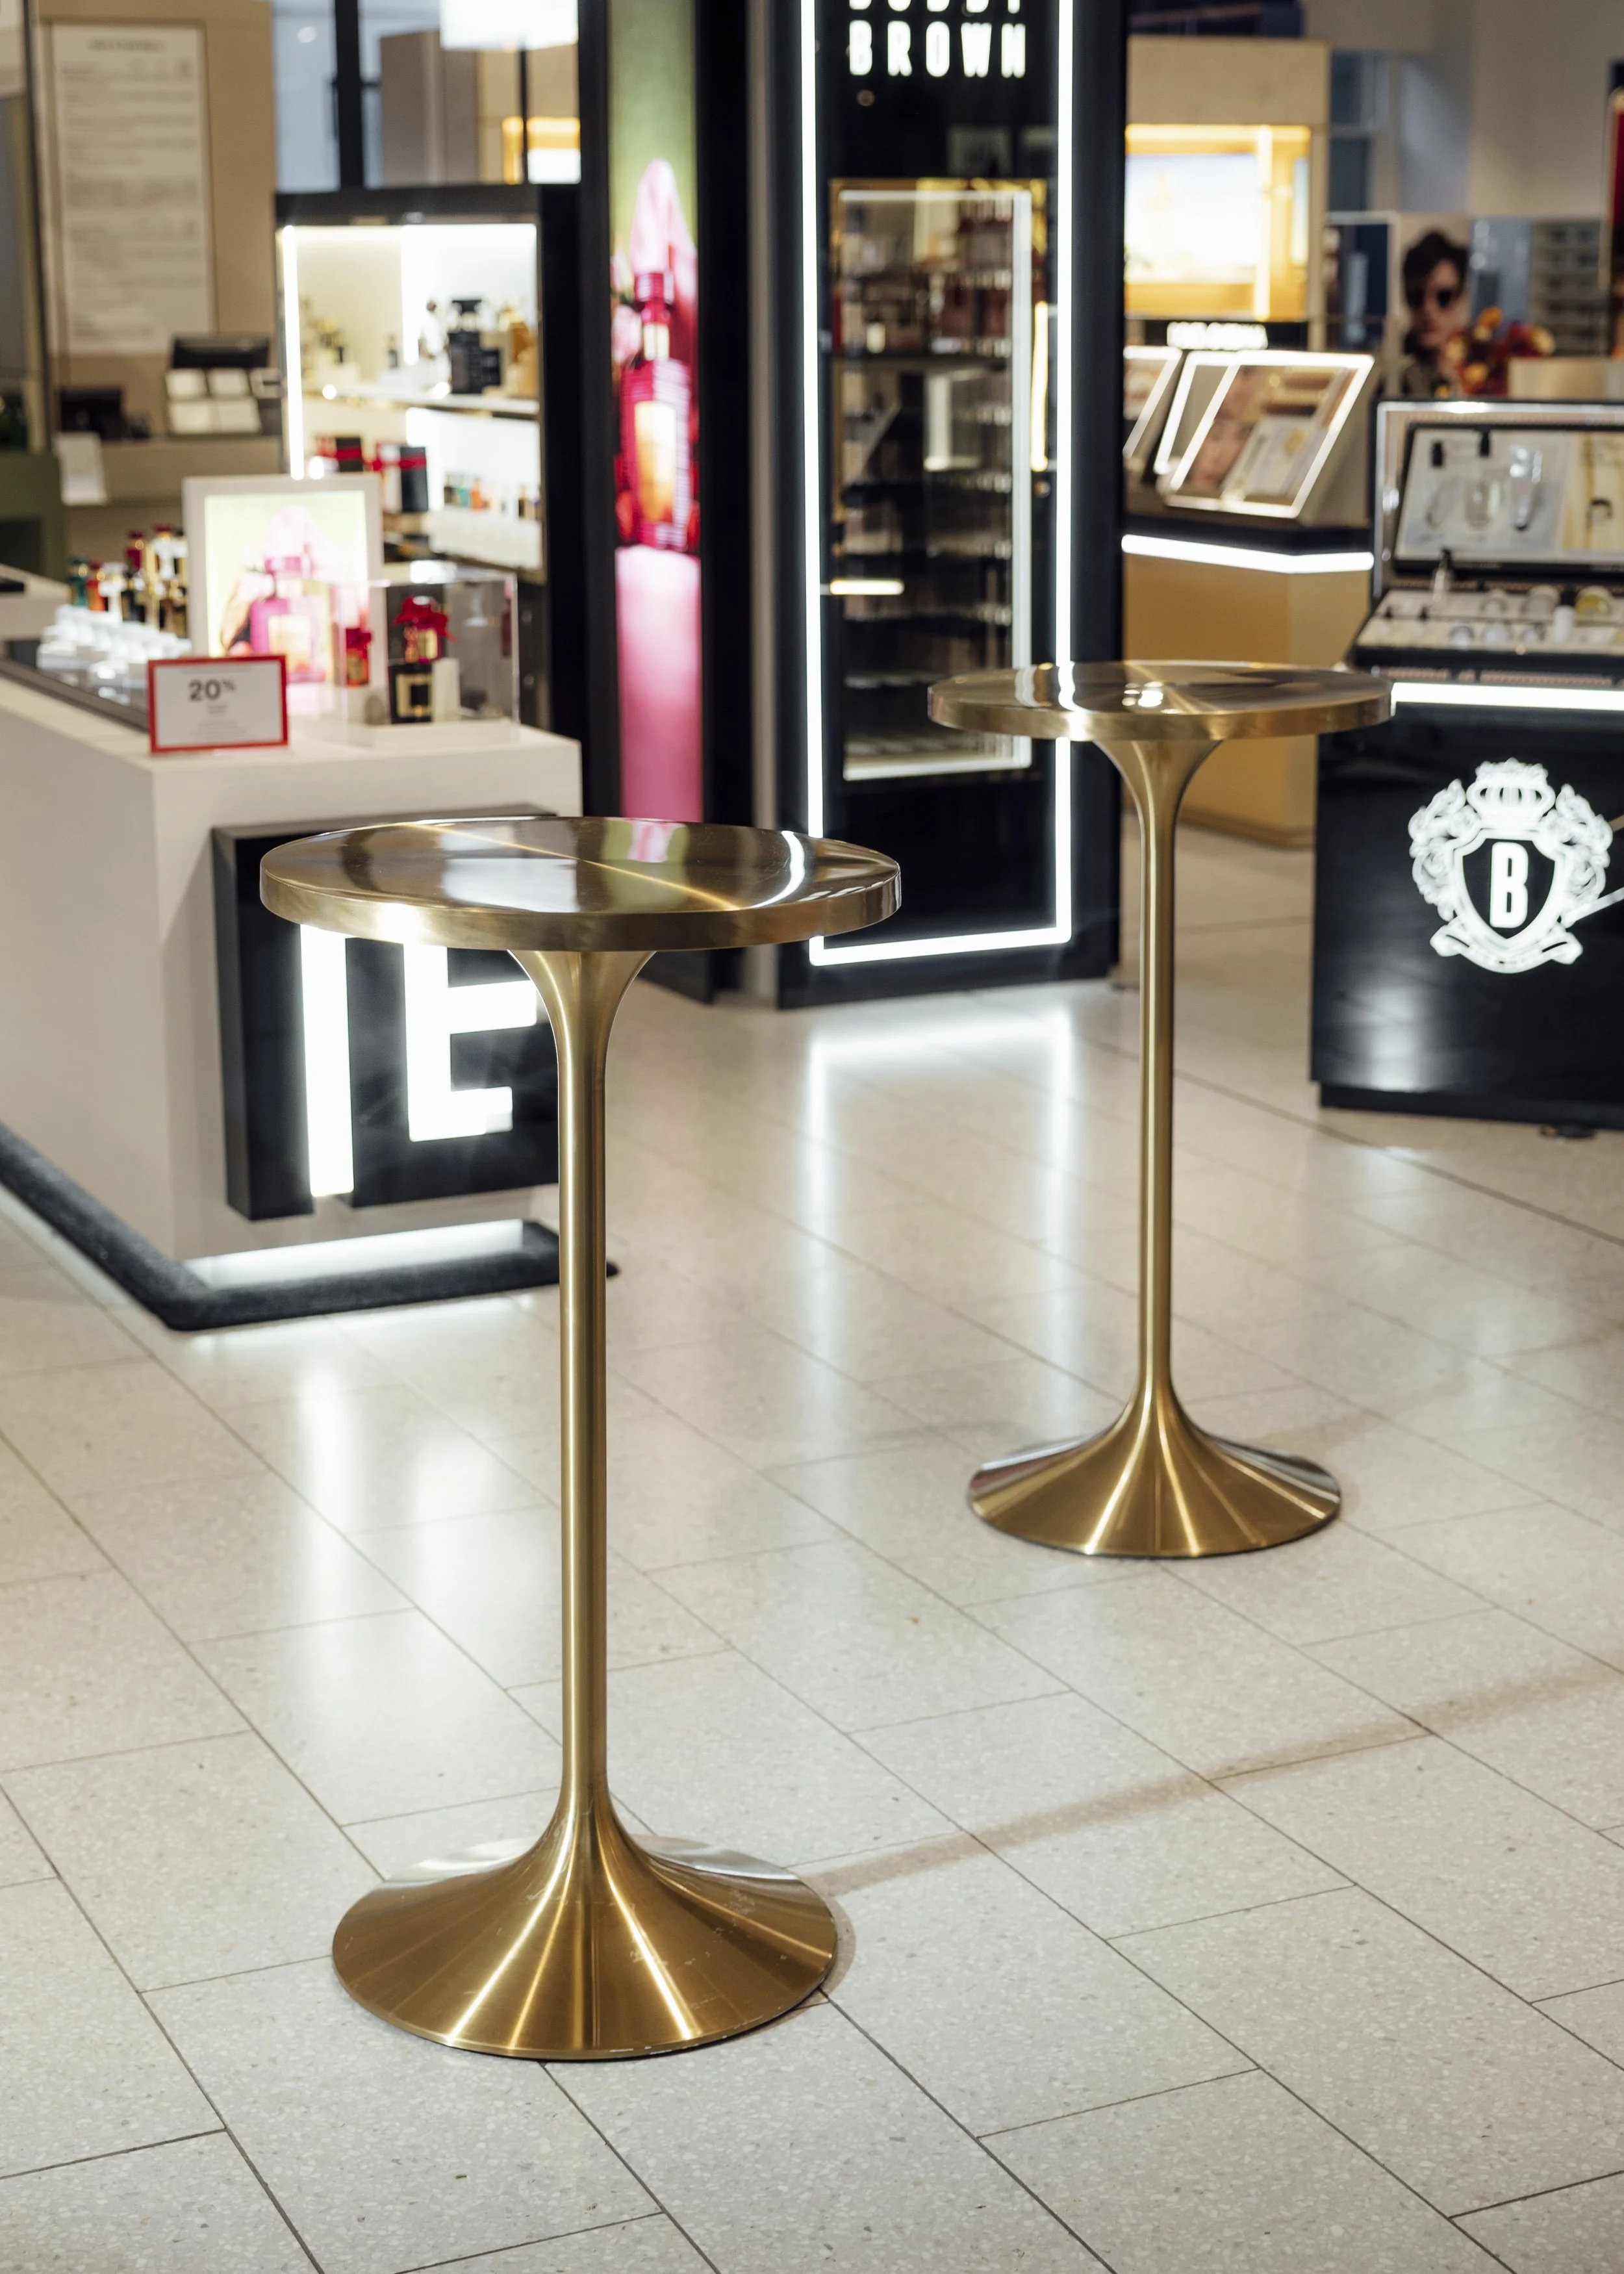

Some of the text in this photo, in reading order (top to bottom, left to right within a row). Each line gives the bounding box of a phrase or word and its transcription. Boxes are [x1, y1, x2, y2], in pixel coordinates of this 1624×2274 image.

[849, 19, 1026, 78] BROWN
[188, 679, 236, 702] 20%
[1490, 841, 1529, 928] B
